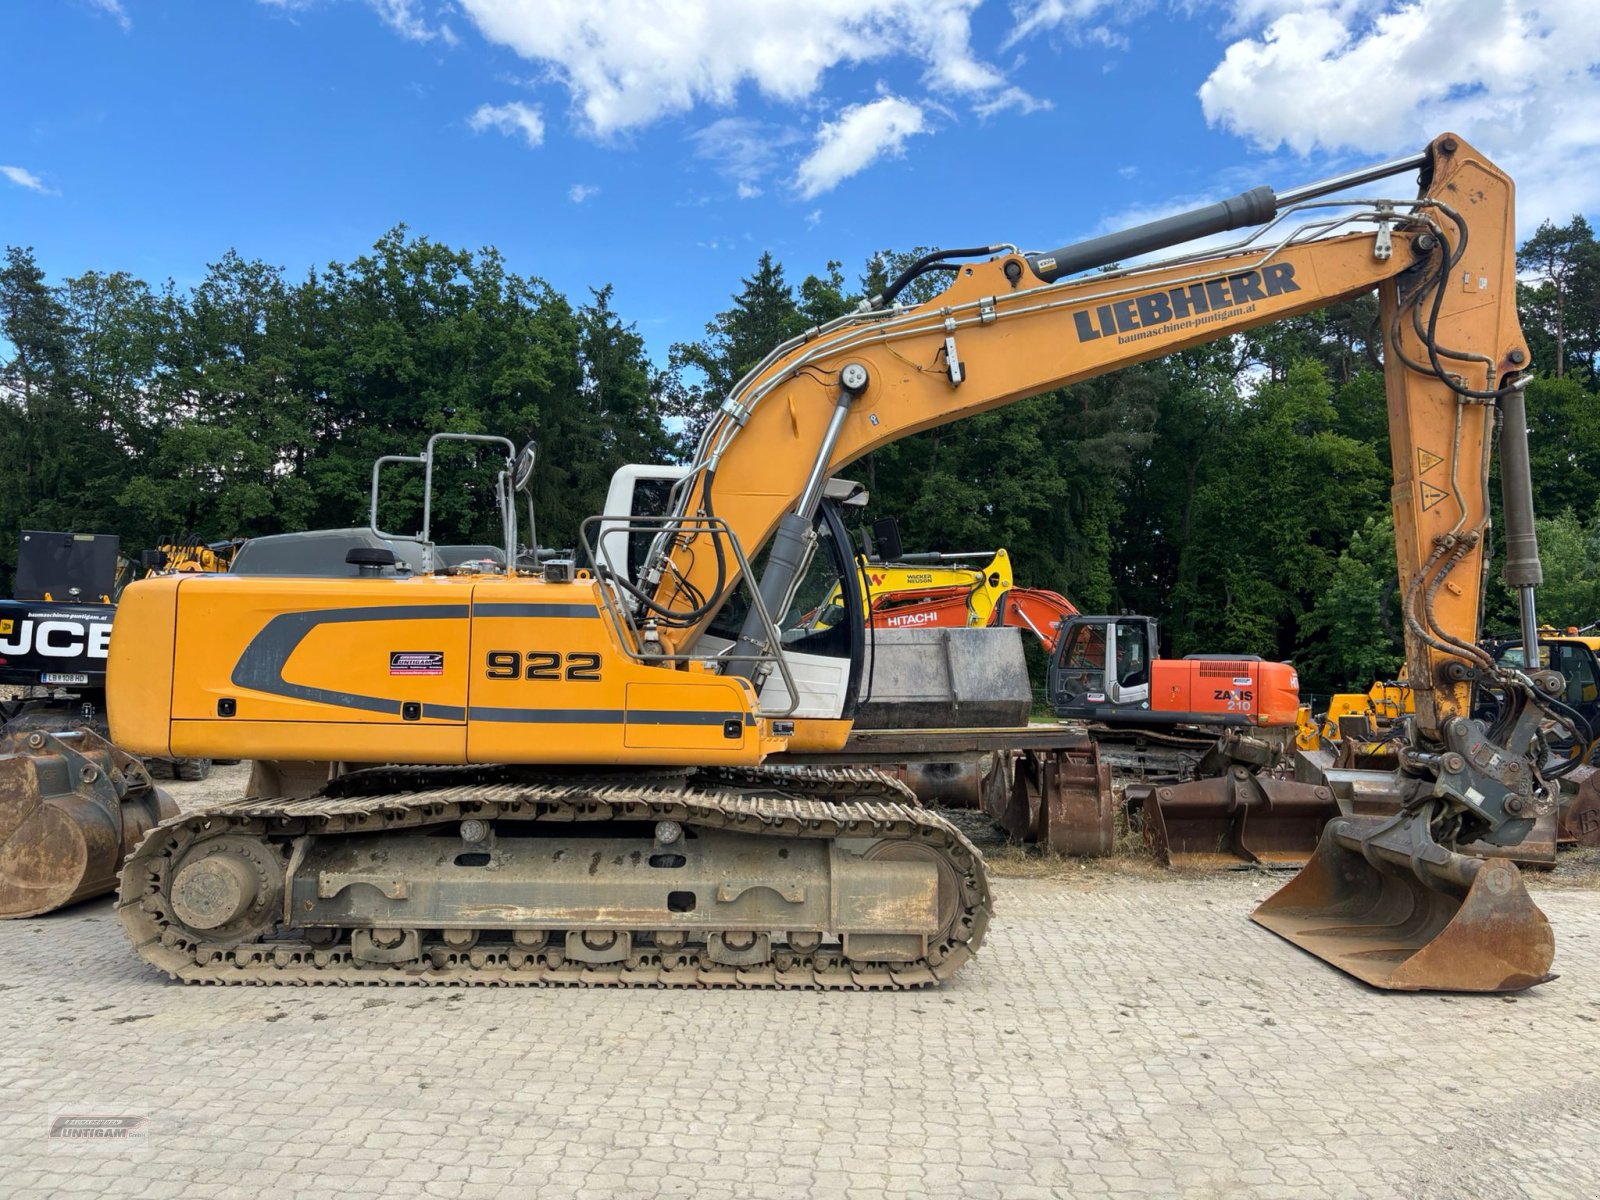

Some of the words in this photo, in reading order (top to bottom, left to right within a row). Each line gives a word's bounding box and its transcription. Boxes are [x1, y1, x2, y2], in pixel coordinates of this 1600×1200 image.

[1073, 262, 1301, 343] LIEBHERR
[1118, 303, 1256, 345] baumaschinen-puntigam.at
[888, 612, 938, 627] HITACHI
[486, 650, 602, 682] 922
[1214, 688, 1253, 701] ZAXIS
[1227, 701, 1251, 711] 210
